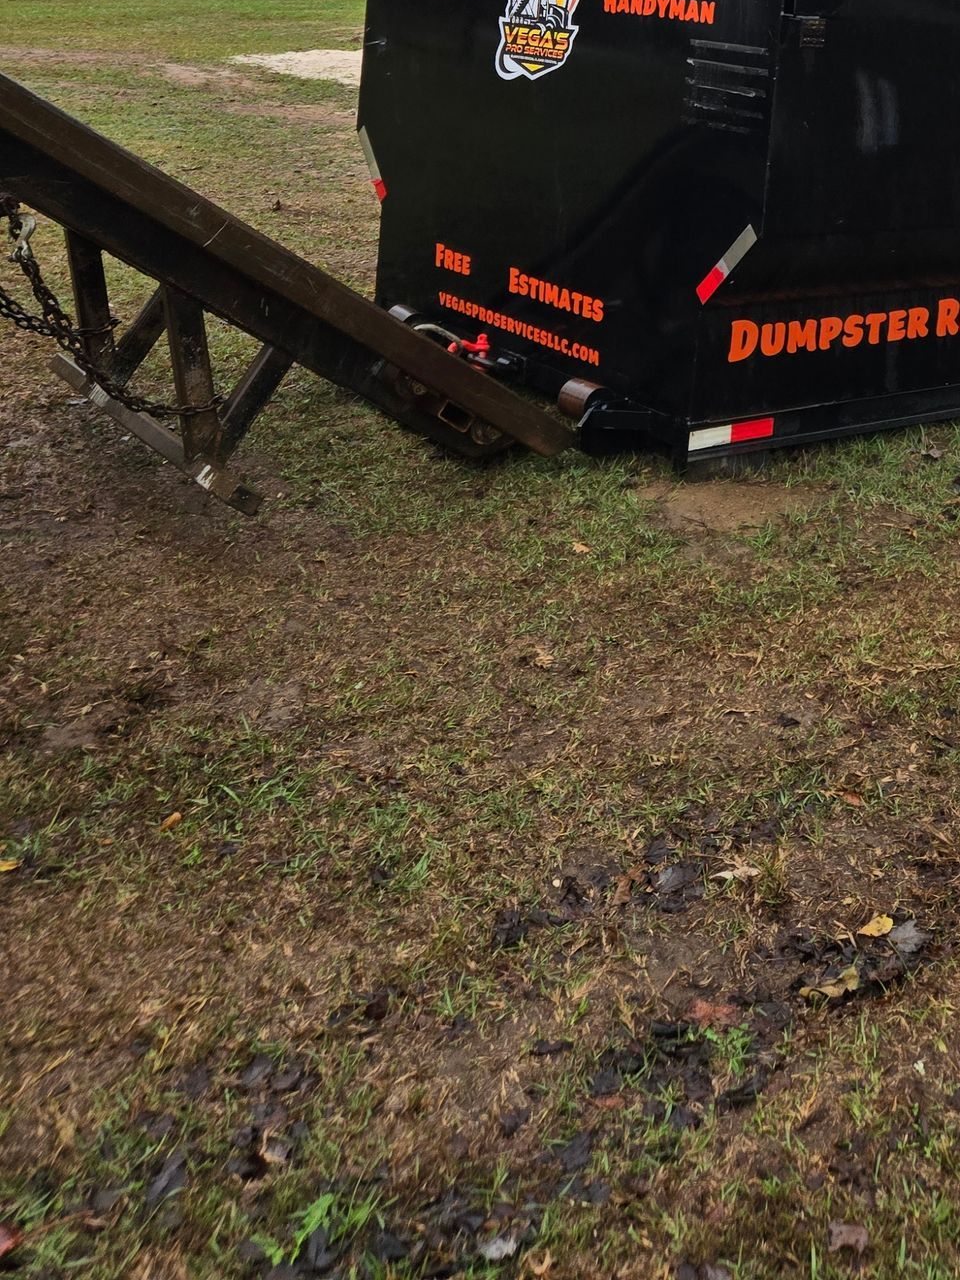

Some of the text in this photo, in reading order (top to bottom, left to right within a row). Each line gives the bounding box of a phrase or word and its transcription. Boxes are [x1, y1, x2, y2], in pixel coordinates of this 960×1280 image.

[504, 25, 570, 50] VEGA'S
[505, 44, 565, 59] PRO SERVICES
[435, 242, 604, 323] FREE ESTIMATES
[438, 290, 600, 367] VEGASPROSERVICESLLC.COM
[727, 306, 930, 363] DUMPSTER
